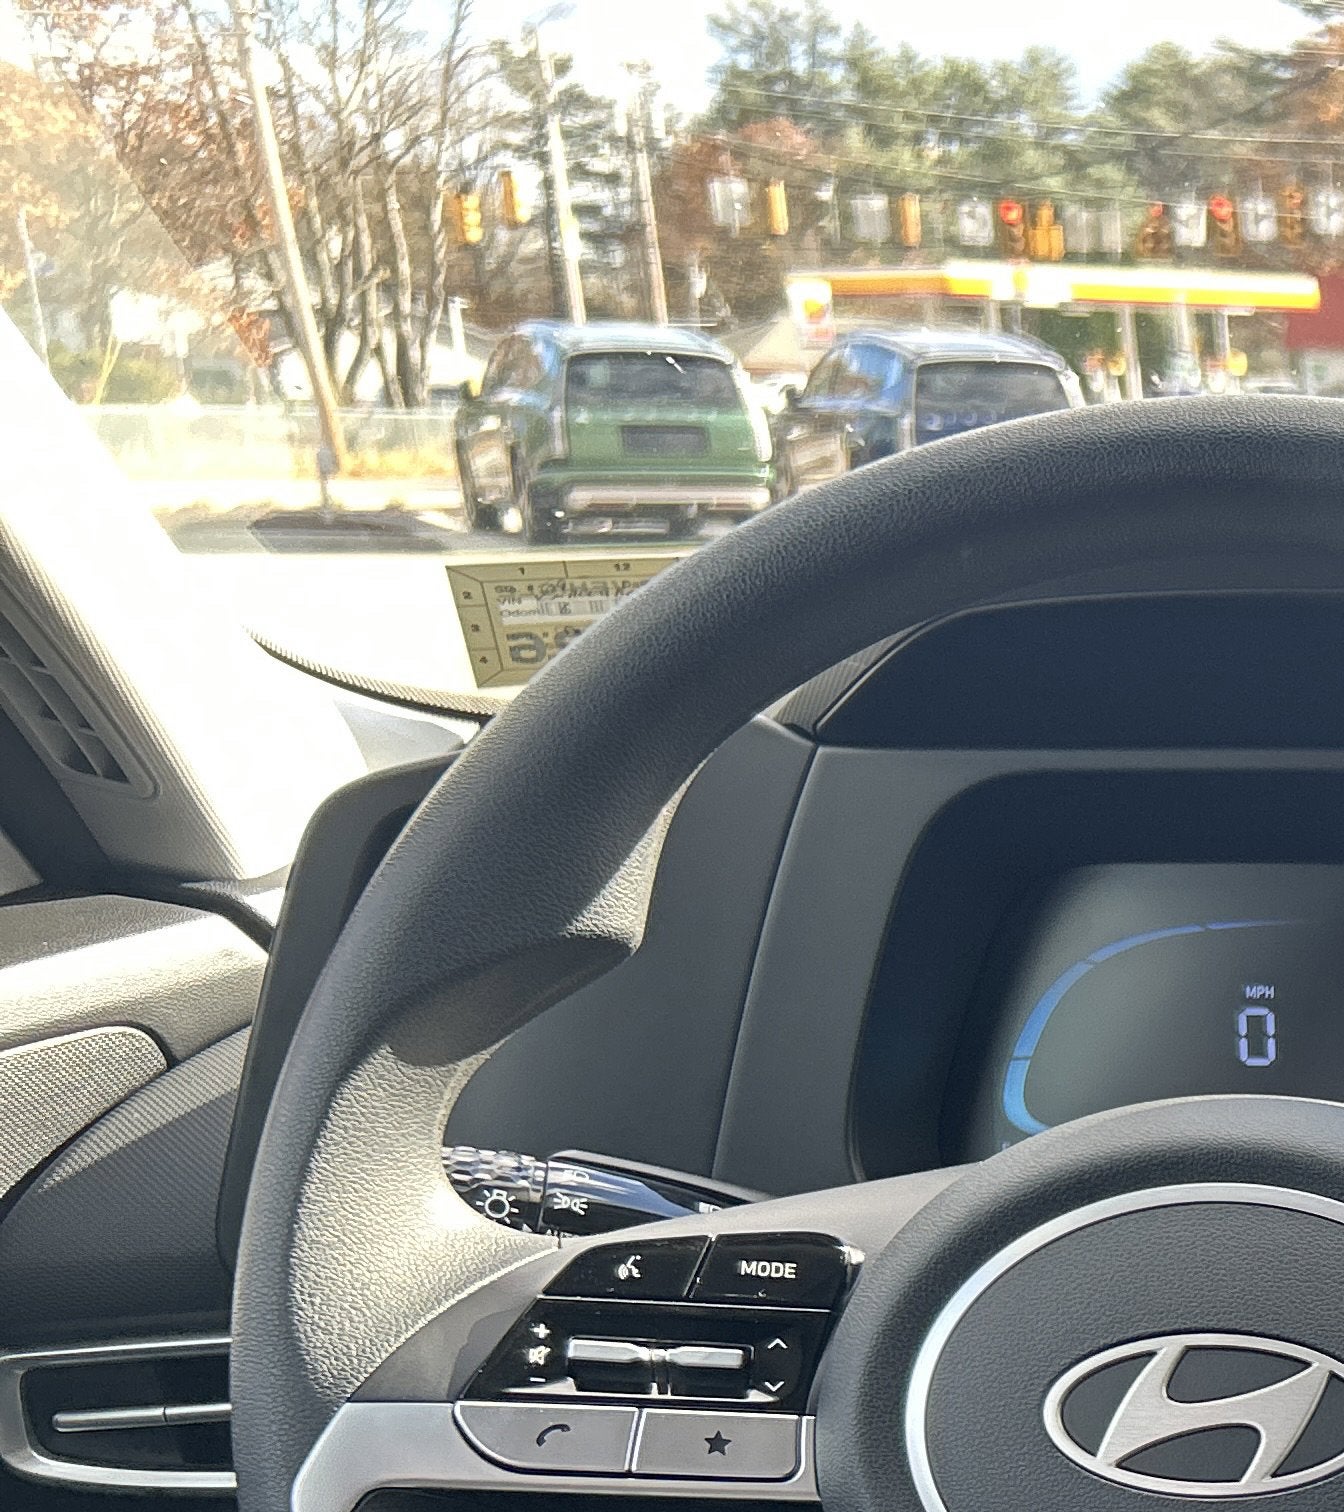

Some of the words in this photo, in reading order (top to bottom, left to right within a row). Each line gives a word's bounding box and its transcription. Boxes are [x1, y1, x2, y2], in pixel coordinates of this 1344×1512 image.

[1245, 984, 1275, 999] MPH
[1237, 1006, 1276, 1067] 0
[740, 1260, 797, 1279] MODE
